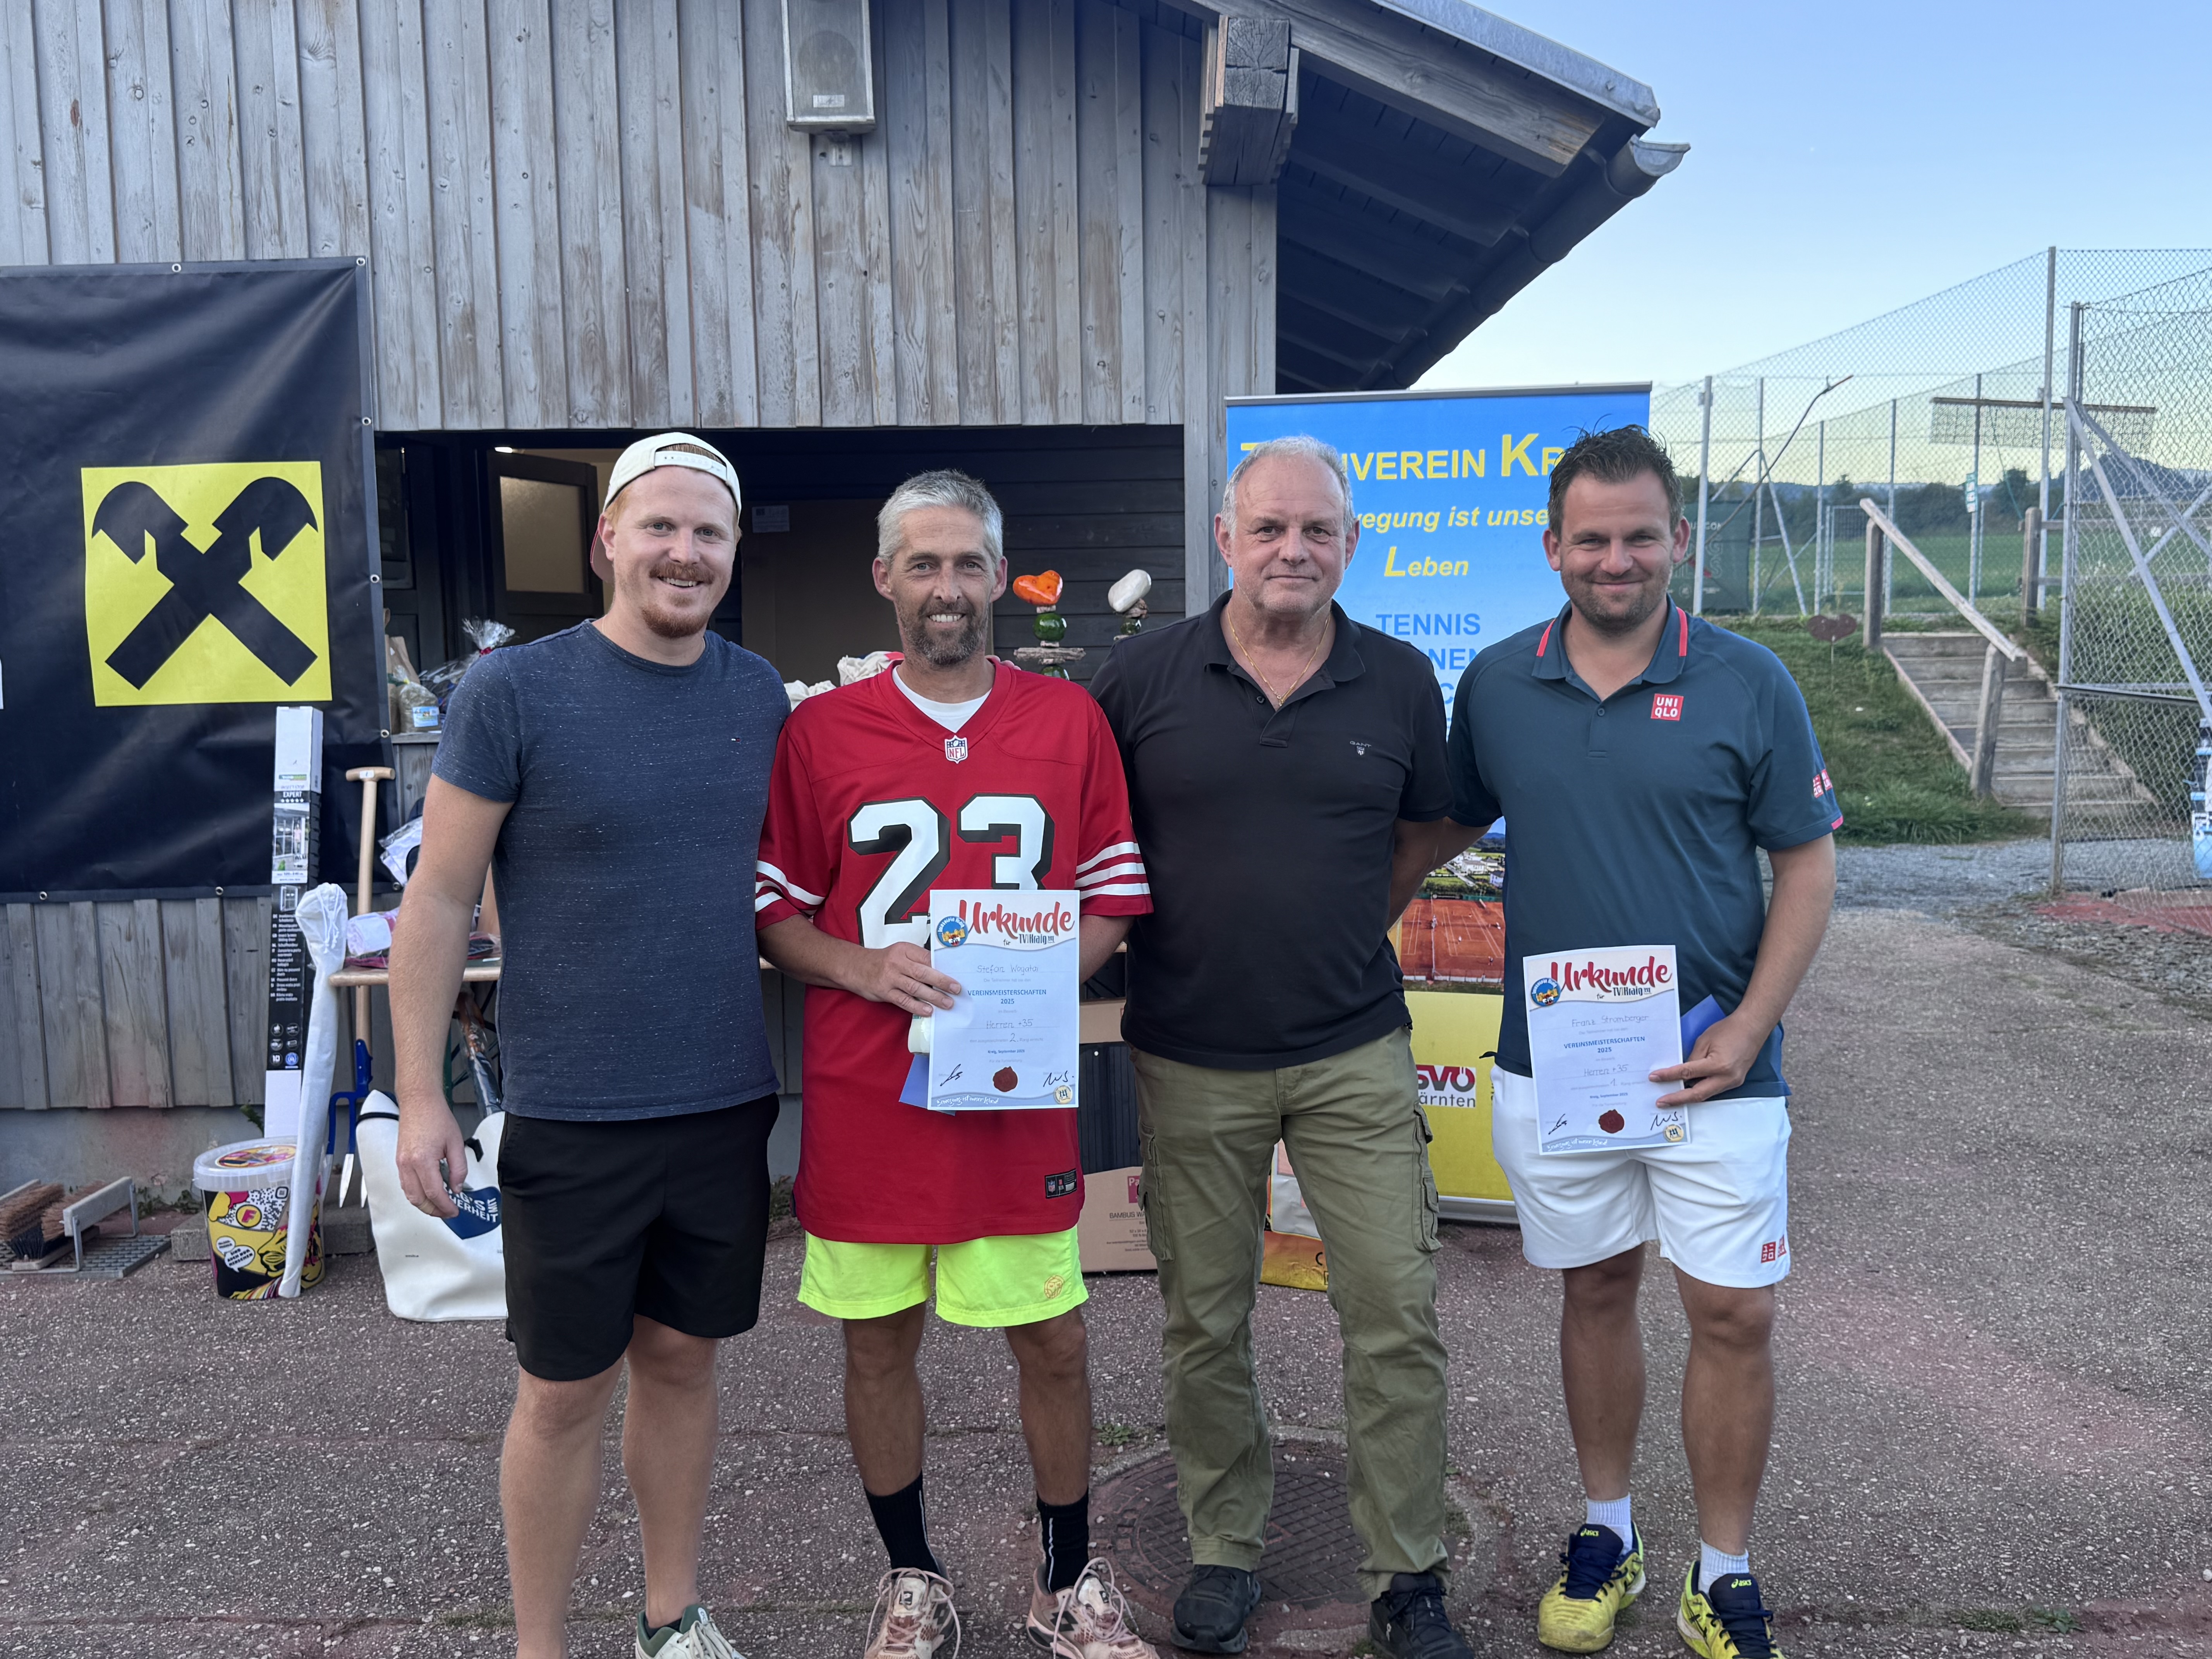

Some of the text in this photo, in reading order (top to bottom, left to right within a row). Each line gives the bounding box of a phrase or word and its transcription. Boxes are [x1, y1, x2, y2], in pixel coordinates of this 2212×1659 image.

[1358, 506, 1549, 533] egung ist unse
[1384, 546, 1468, 576] Leben
[1376, 613, 1480, 635] TENNIS
[1657, 697, 1678, 707] UNI
[1655, 707, 1678, 718] QLO
[949, 748, 964, 758] NFL
[847, 793, 1054, 948] 23
[959, 900, 1075, 939] Urkunde
[976, 965, 1005, 974] Stefan
[1551, 956, 1673, 993] Urkunde
[987, 1020, 1014, 1029] Herren
[1601, 1015, 1649, 1024] Stromberger
[1564, 1036, 1645, 1049] VEREINSMEISTERSCHAFTEN
[1416, 1065, 1475, 1092] SVÖ
[1583, 1068, 1610, 1077] Herren
[1419, 1092, 1475, 1108] ärnten
[241, 1209, 256, 1223] F
